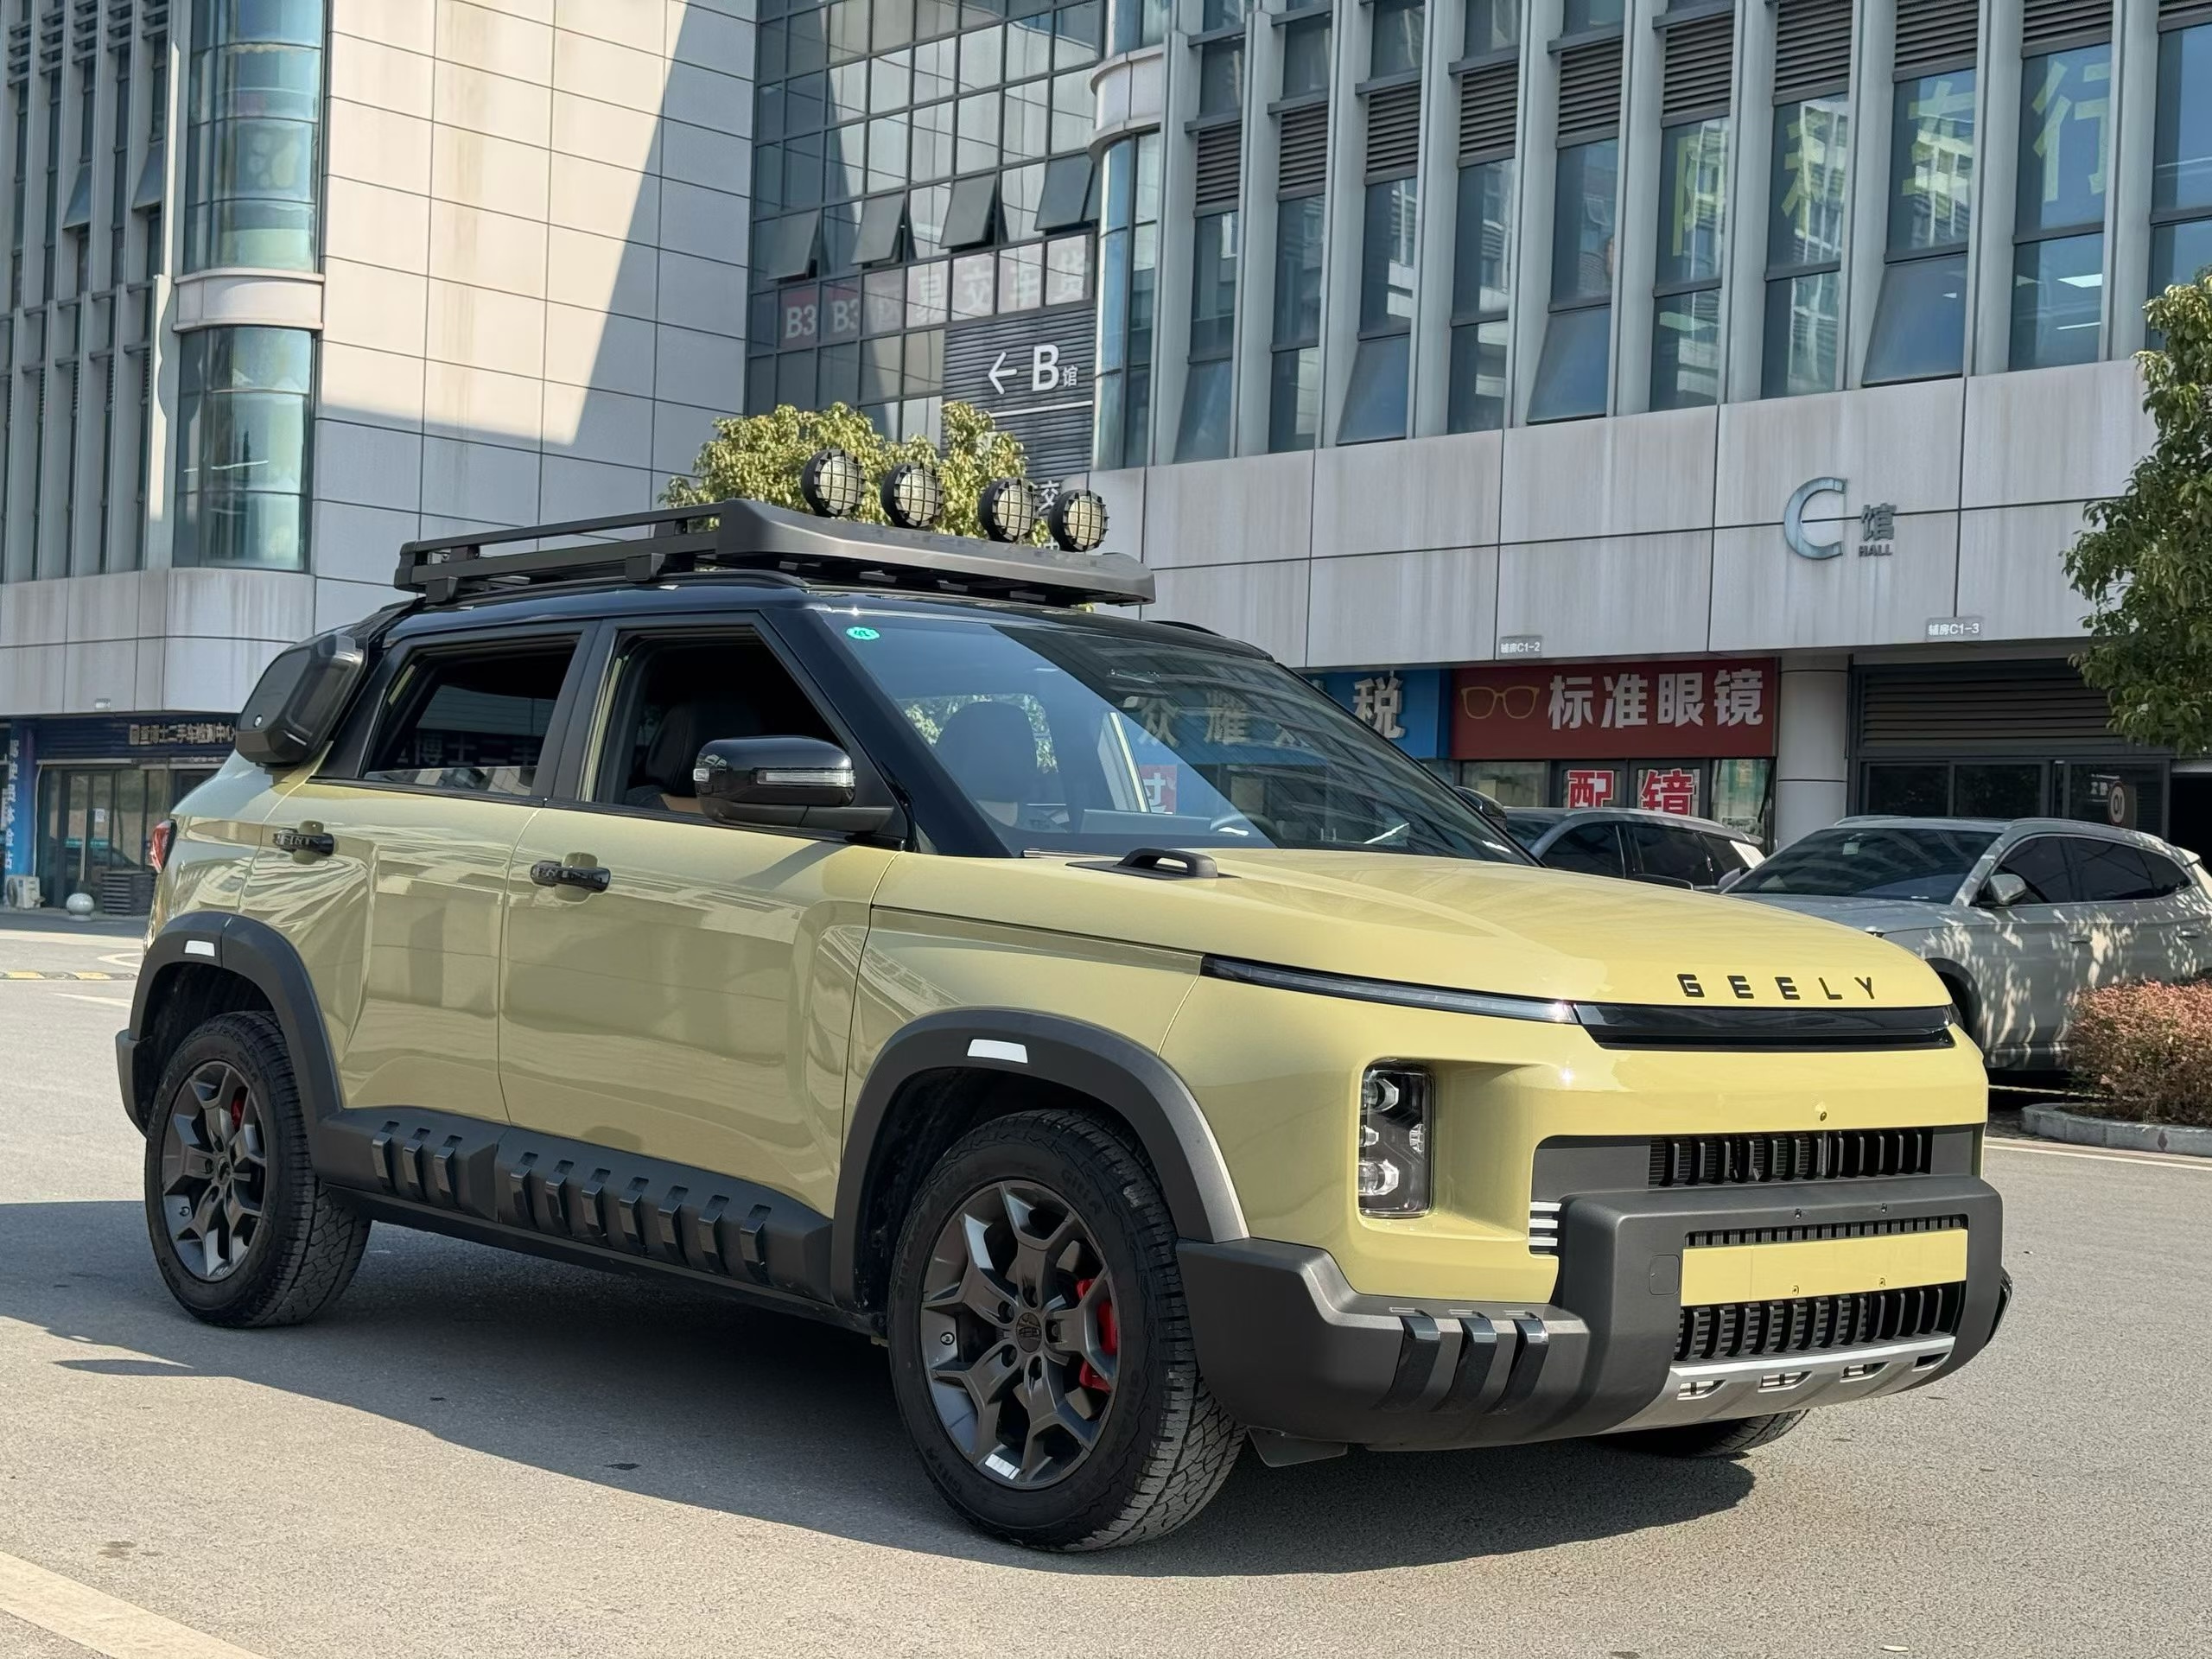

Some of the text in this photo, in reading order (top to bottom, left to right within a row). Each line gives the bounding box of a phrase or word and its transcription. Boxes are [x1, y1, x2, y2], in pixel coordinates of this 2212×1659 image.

[785, 303, 817, 340] B3
[1032, 344, 1078, 392] B馆
[1858, 544, 1893, 557] HALL
[1547, 668, 1764, 731] 标准眼镜
[1676, 973, 1875, 1001] GEELY
